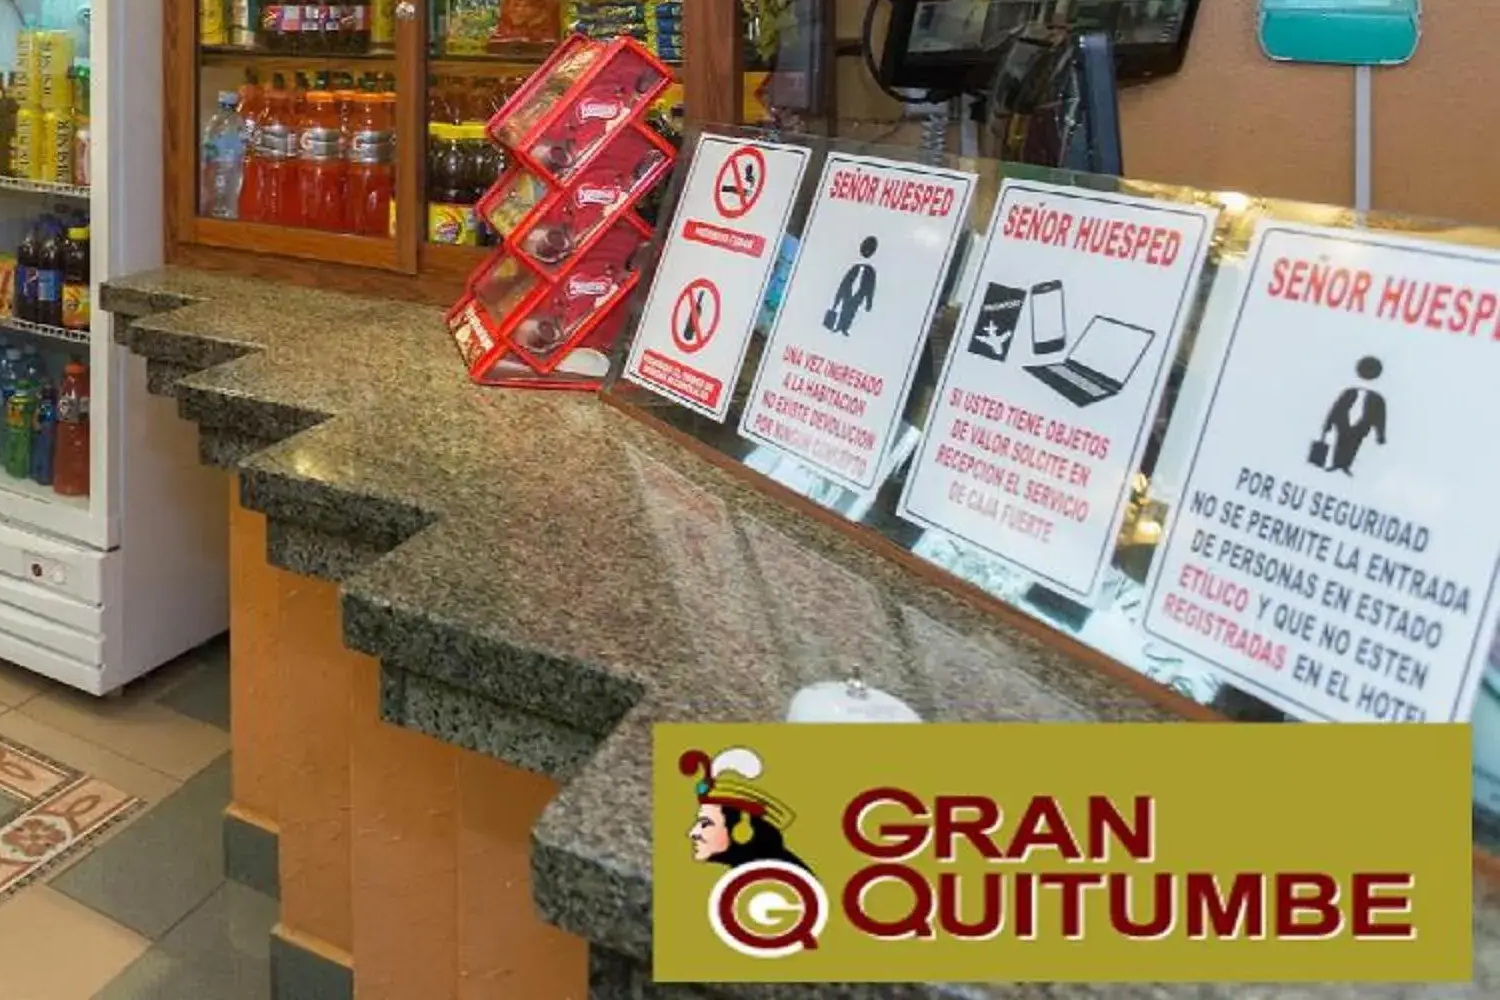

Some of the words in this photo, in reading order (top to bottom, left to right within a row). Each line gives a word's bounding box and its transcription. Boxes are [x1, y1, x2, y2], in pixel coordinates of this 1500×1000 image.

[830, 167, 880, 205] SEÑOR
[879, 177, 955, 216] HUESPED
[1003, 202, 1073, 247] SEÑOR
[1073, 216, 1182, 267] HUESPED
[1268, 253, 1372, 313] SEÑOR
[791, 375, 805, 391] LA
[806, 380, 867, 416] HABITACION
[803, 353, 825, 375] VEZ
[824, 360, 884, 397] INGRESADO
[762, 390, 777, 409] NO
[776, 396, 810, 423] EXISTE
[809, 409, 876, 450] DEVOLUCION
[949, 388, 963, 407] SI
[963, 392, 1004, 421] USTED
[1005, 406, 1045, 438] TIENE
[1045, 420, 1111, 460] OBJETOS
[951, 418, 969, 441] DE
[971, 424, 1011, 456] VALOR
[1011, 441, 1068, 480] SOLCITE
[1069, 462, 1092, 488] EN
[935, 443, 1007, 488] RECEPCION
[1004, 472, 1021, 496] EL
[1023, 480, 1091, 522] SERVICIO
[948, 480, 968, 505] DE
[1000, 504, 1056, 544] FUERTE
[1236, 467, 1274, 499] POR
[1277, 481, 1306, 511] SU
[1308, 491, 1430, 554] SEGURIDAD
[1190, 490, 1218, 519] NO
[1219, 500, 1244, 529] SE
[1246, 510, 1333, 562] PERMITE
[1334, 540, 1360, 574] LA
[1365, 553, 1472, 616] ENTRADA
[1190, 529, 1217, 559] DE
[1218, 538, 1320, 599] PERSONAS
[1321, 579, 1353, 613] EN
[1354, 593, 1444, 650] ESTADO
[1161, 593, 1288, 671] REGISTRADAS
[1292, 653, 1323, 689] EN
[1325, 670, 1352, 702] EL
[1177, 564, 1250, 614] ETILICO
[1255, 595, 1270, 621] Y
[1273, 603, 1316, 642] QUE
[1318, 619, 1352, 656] NO
[1354, 637, 1431, 692] ESTEN
